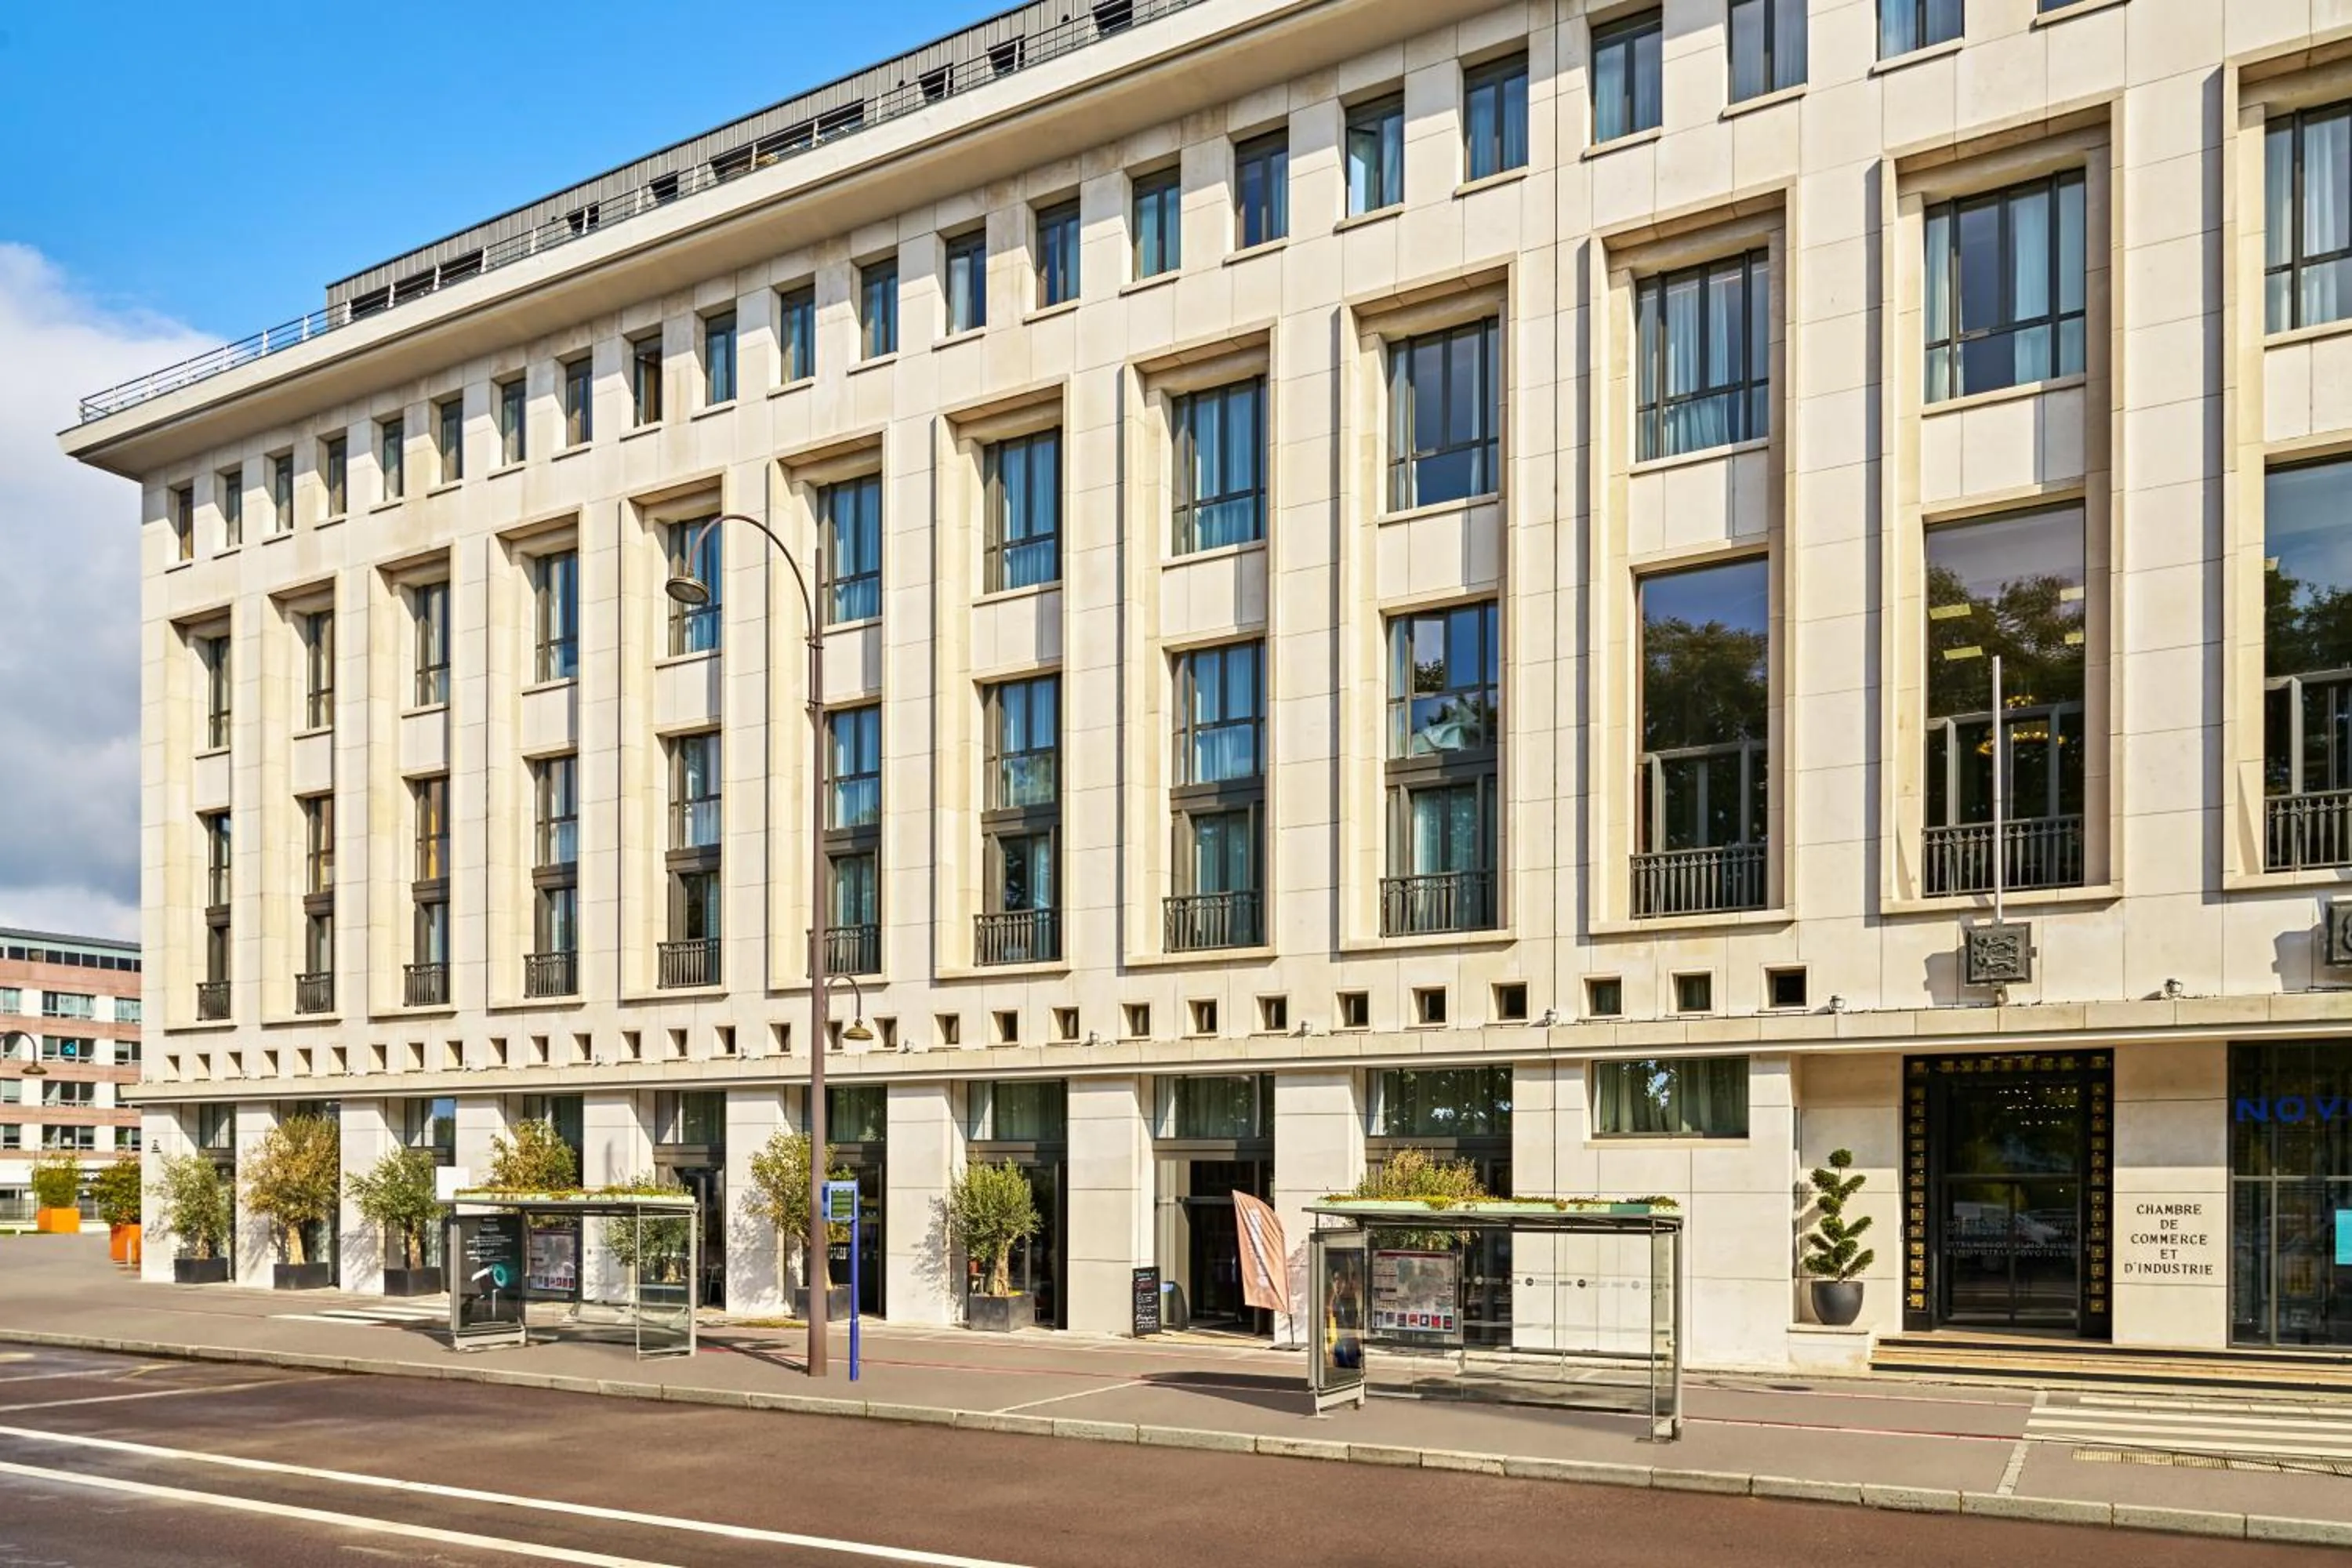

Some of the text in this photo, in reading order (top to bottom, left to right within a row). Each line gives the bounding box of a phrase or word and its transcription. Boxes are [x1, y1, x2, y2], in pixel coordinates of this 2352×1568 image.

[2235, 1095, 2352, 1122] NOV
[2136, 1203, 2202, 1215] CHAMBRE
[2160, 1218, 2179, 1230] DE
[2130, 1232, 2209, 1245] COMMERCE
[2160, 1248, 2179, 1260] ET
[2124, 1261, 2213, 1276] D'INDUSTRIE
